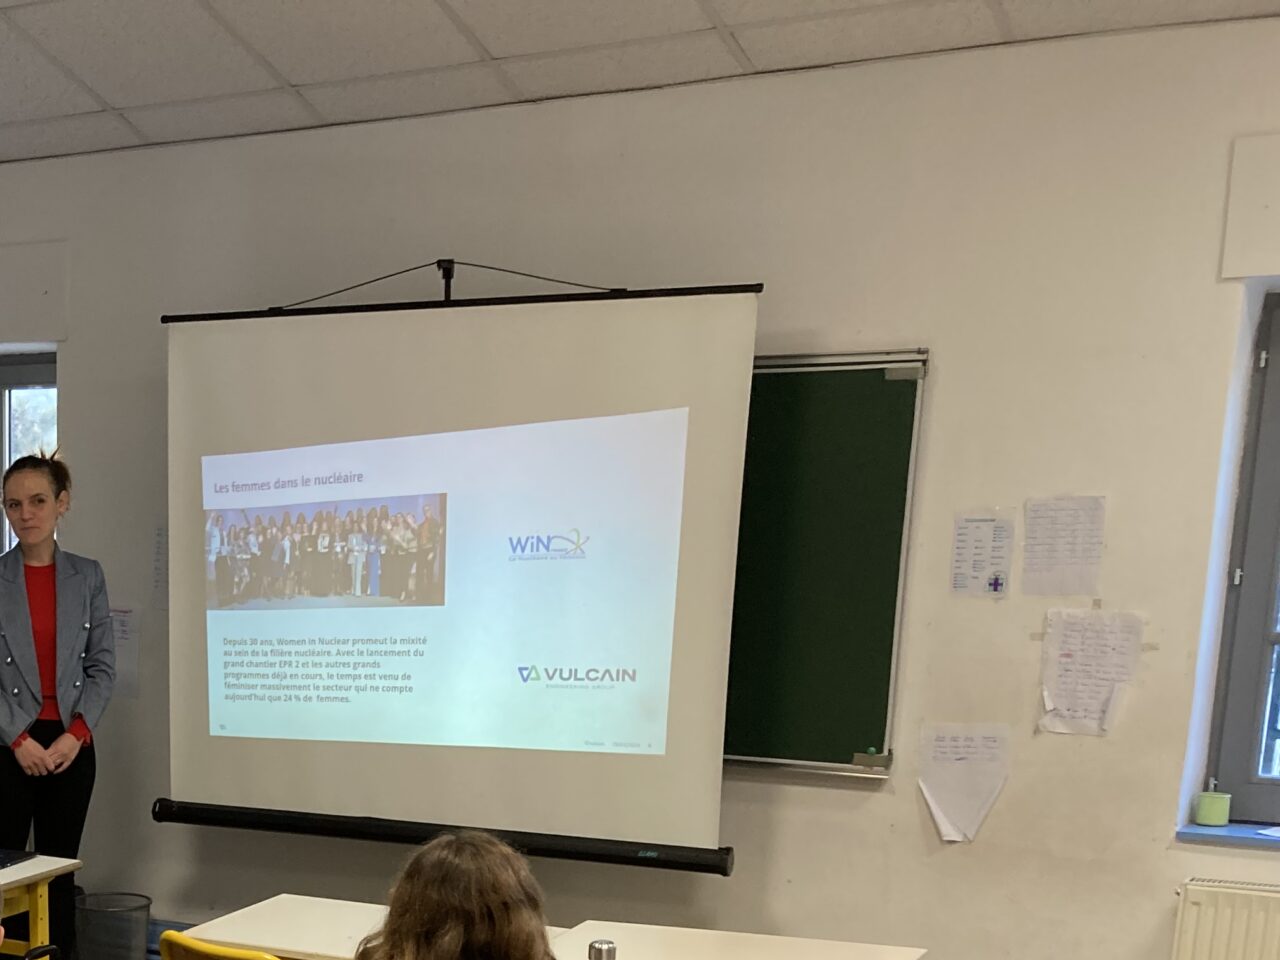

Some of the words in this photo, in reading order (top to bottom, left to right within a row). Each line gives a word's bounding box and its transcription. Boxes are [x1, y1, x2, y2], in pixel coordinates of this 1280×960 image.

[214, 482, 229, 494] Les
[231, 480, 271, 492] femmes
[273, 477, 298, 490] dans
[301, 475, 311, 487] le
[314, 471, 364, 486] nucléaire
[223, 638, 248, 647] Depuis
[249, 638, 258, 646] 30
[260, 639, 275, 647] ans,
[276, 637, 307, 646] Women
[308, 637, 316, 646] in
[318, 637, 350, 646] Nuclear
[352, 637, 387, 647] promeut
[390, 637, 398, 645] la
[400, 636, 427, 645] mixité
[234, 648, 249, 657] sein
[251, 648, 260, 657] de
[261, 648, 269, 657] la
[270, 648, 292, 657] filière
[294, 648, 333, 657] nucléaire.
[335, 648, 357, 657] Avec
[357, 648, 365, 657] le
[366, 648, 411, 657] lancement
[413, 648, 425, 657] du
[223, 660, 245, 670] grand
[246, 660, 277, 668] chantier
[278, 660, 293, 668] EPR
[295, 660, 300, 668] 2
[311, 660, 323, 668] les
[352, 660, 381, 670] grands
[223, 671, 269, 681] programmes
[271, 671, 288, 681] déjà
[301, 673, 325, 681] cours,
[327, 672, 335, 680] le
[336, 672, 362, 682] temps
[363, 673, 377, 681] est
[378, 673, 399, 681] venu
[401, 672, 412, 681] de
[544, 667, 637, 682] VULCAIN
[224, 682, 258, 690] féminiser
[260, 683, 311, 691] massivement
[313, 683, 321, 691] le
[322, 684, 352, 692] secteur
[354, 683, 368, 693] qui
[369, 684, 380, 692] ne
[381, 684, 414, 694] compte
[267, 694, 282, 703] que
[283, 694, 293, 702] 24
[302, 694, 313, 703] de
